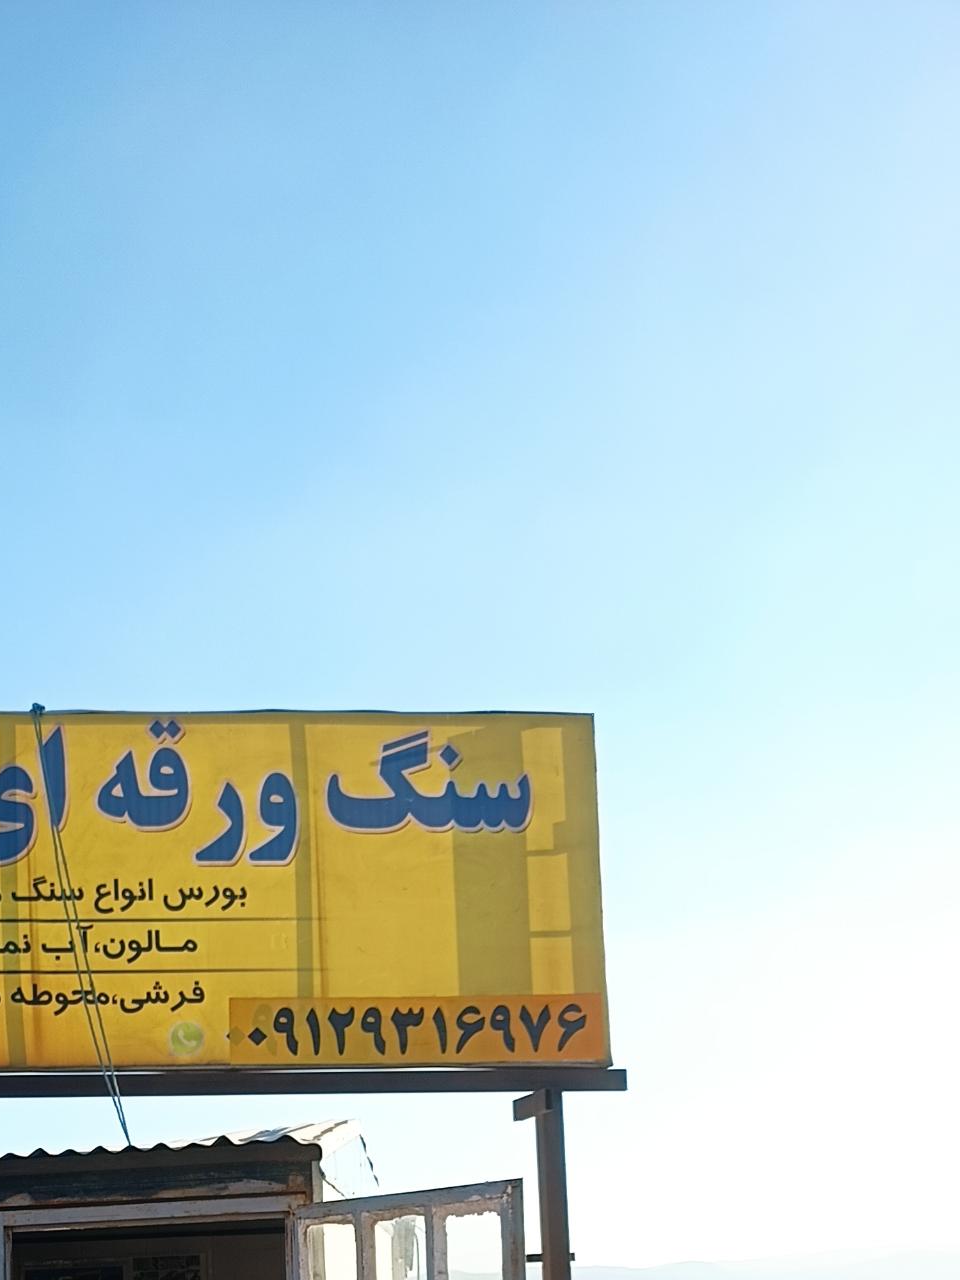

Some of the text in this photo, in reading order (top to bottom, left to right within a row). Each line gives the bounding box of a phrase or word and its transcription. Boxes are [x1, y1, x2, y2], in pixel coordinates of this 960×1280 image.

[96, 719, 300, 865] ورقه
[325, 731, 534, 832] سنگ
[10, 875, 85, 903] سنگ
[93, 877, 154, 913] انواع
[162, 885, 248, 912] بورس
[247, 1003, 588, 1056] ۰۹۱۲۹۳۱۶۹۷۶
